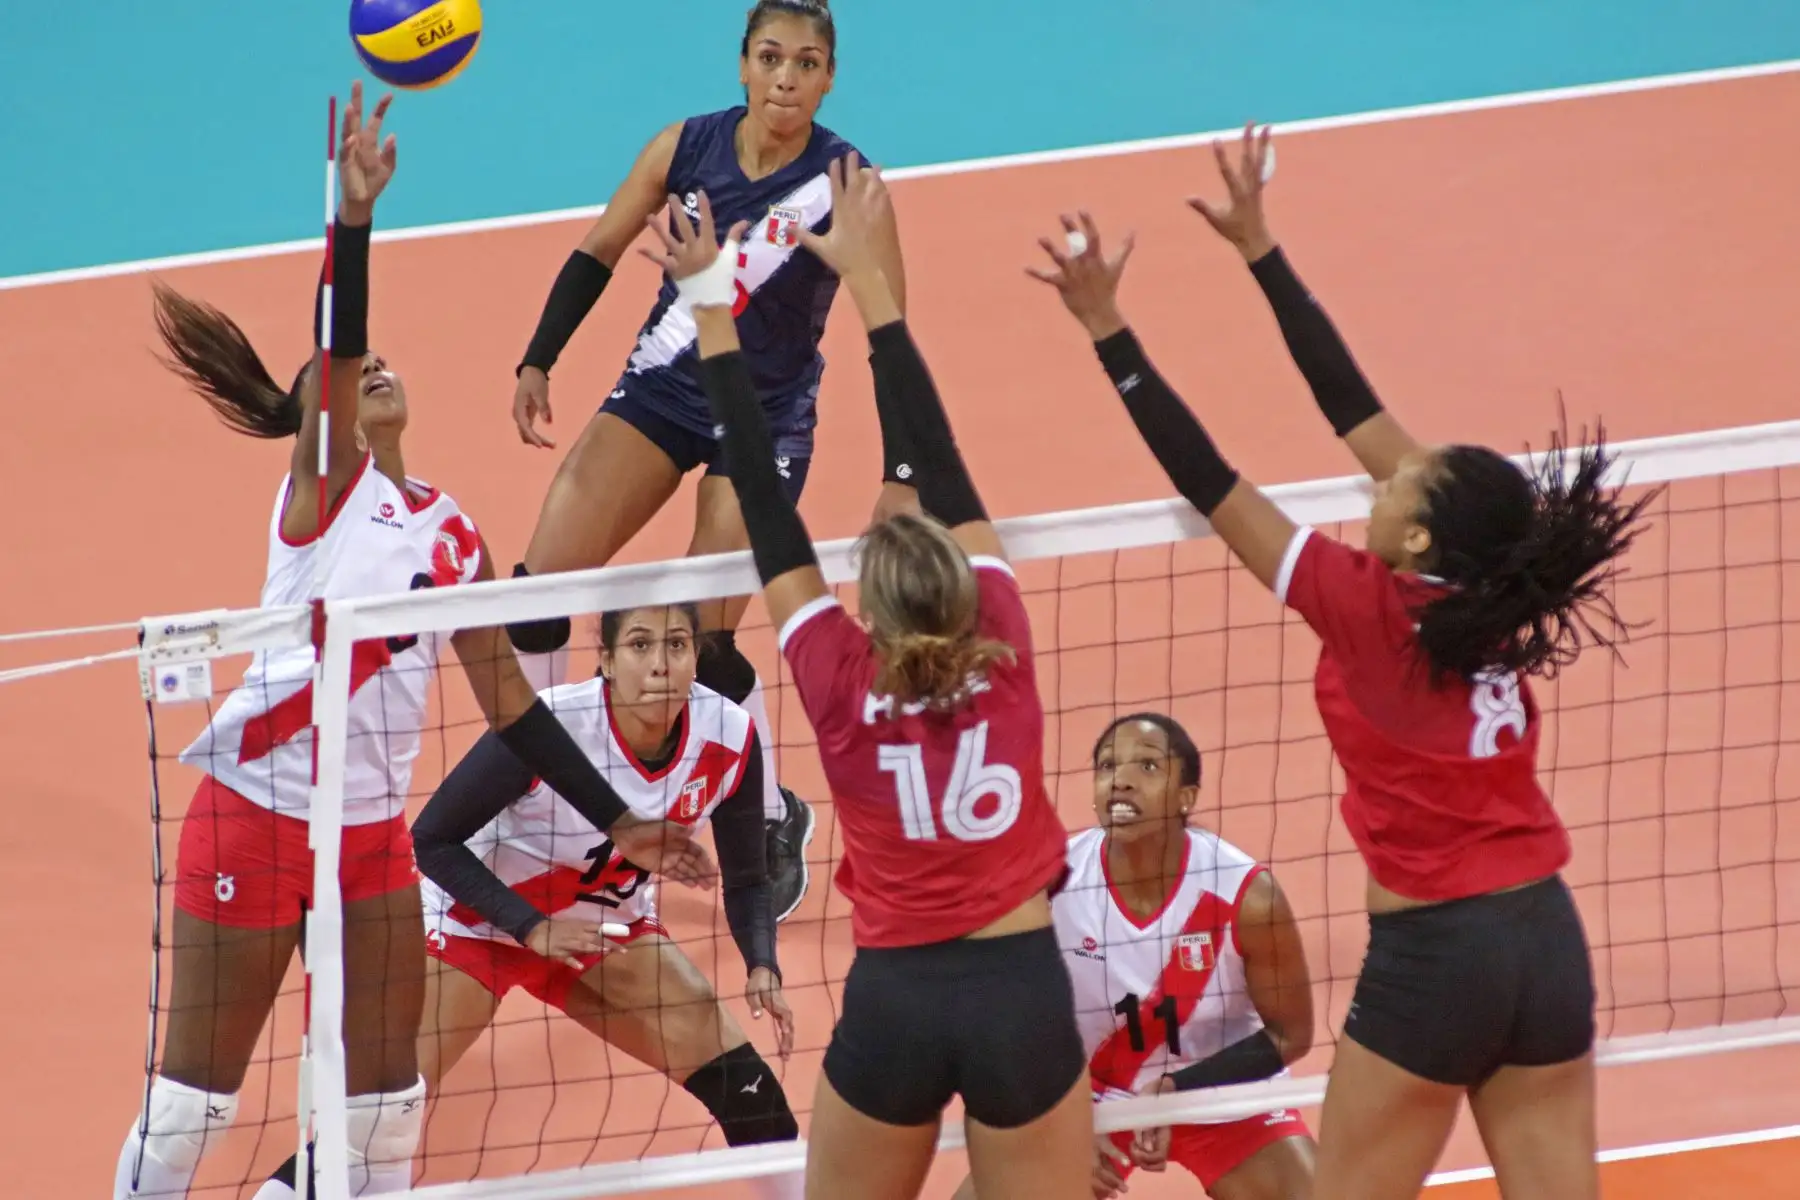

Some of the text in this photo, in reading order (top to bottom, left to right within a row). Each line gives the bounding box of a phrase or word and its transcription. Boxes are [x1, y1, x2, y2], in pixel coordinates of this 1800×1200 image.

[773, 210, 797, 220] PERU
[370, 515, 404, 530] WALON
[1470, 663, 1527, 758] 8
[685, 780, 704, 791] PERU
[877, 719, 1023, 841] 16
[1182, 935, 1208, 944] PERU
[1114, 992, 1182, 1057] 11
